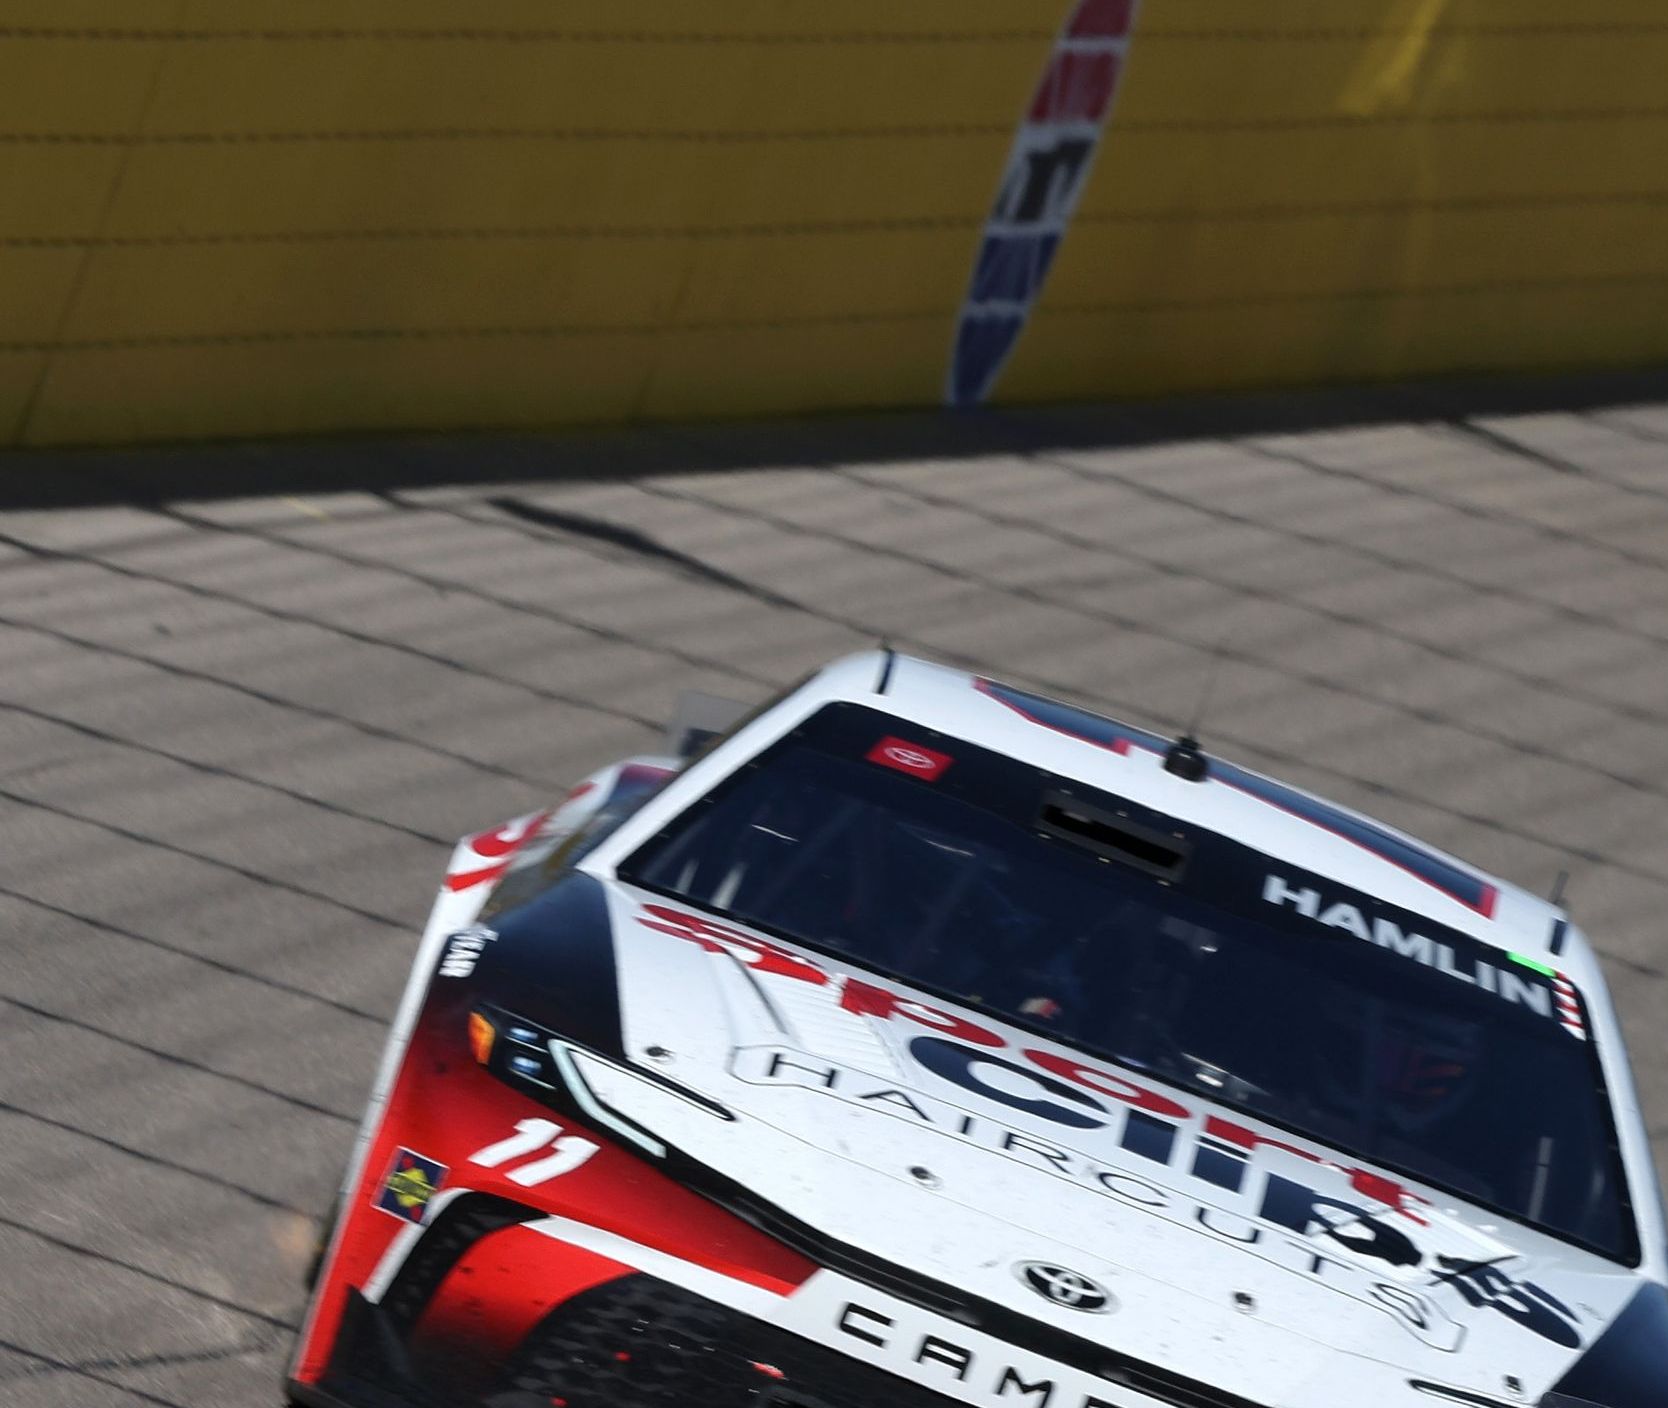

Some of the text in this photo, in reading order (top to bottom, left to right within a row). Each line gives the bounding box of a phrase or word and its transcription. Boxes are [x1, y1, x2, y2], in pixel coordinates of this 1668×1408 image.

[1262, 874, 1552, 1018] HAMLIN
[466, 1118, 600, 1187] 11
[767, 1052, 1432, 1330] HAIRCUTS
